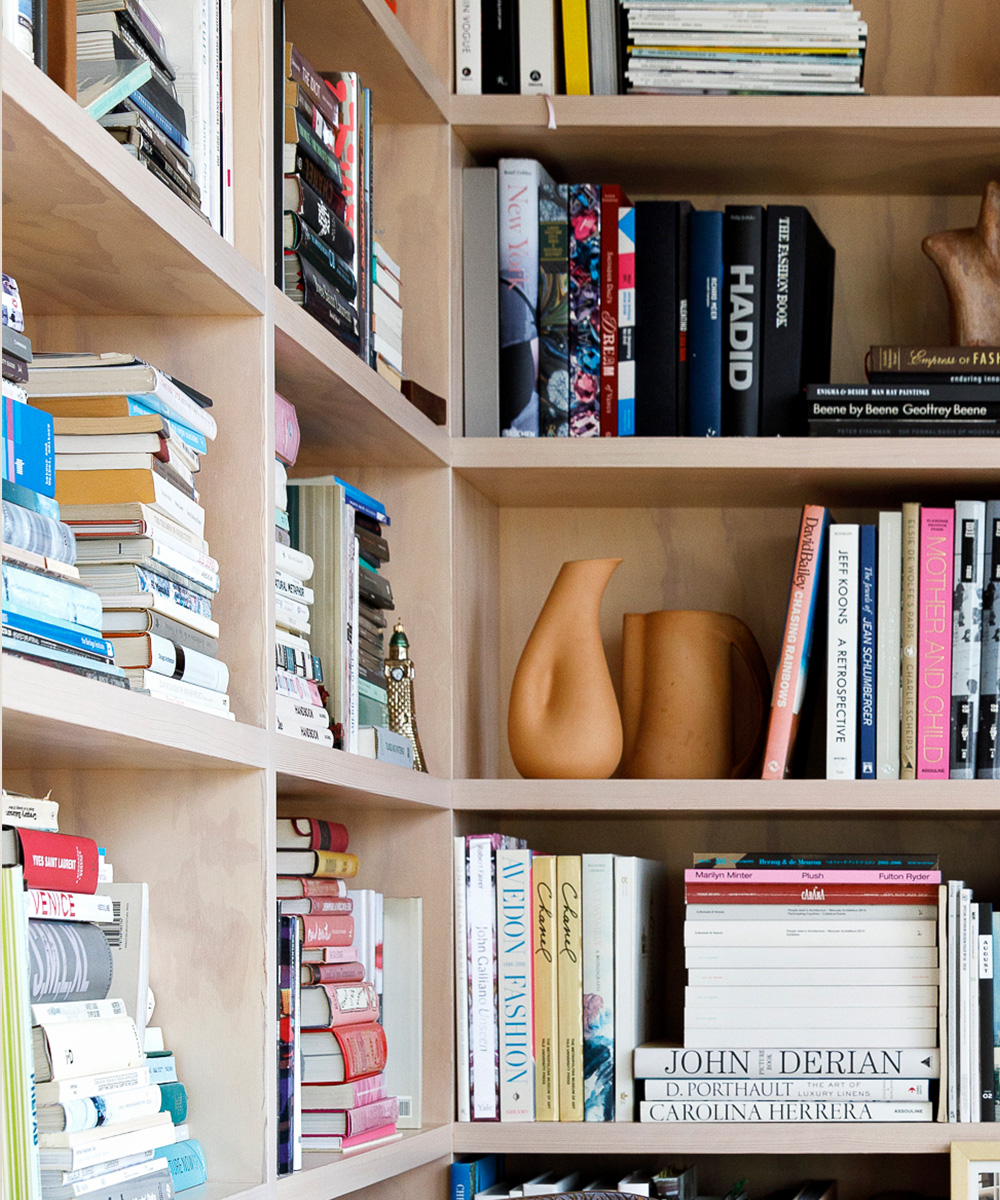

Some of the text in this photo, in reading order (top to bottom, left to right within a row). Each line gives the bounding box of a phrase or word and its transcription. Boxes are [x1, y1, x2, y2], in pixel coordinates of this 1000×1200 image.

[507, 185, 528, 290] New York
[776, 217, 790, 328] THE FASHION BOOK
[729, 265, 755, 391] HADID
[813, 403, 847, 415] Beene
[849, 403, 863, 417] by
[865, 403, 899, 415] Beene
[903, 404, 951, 418] Geoffrey
[953, 404, 987, 416] Beene
[950, 376, 982, 384] enduring
[777, 590, 804, 708] CHASING RAINBOWS
[836, 550, 849, 743] JEFF KOONS A RETROSPECTIVE
[862, 566, 874, 726] The Jewels of JEAN SCHLUMBERGER
[923, 536, 946, 763] MOTHER AND CHILD
[32, 854, 77, 870] YVES SAINT LAURENT
[695, 871, 724, 880] Marilyn
[906, 873, 930, 881] Ryder
[30, 891, 76, 917] VENICE
[535, 882, 552, 963] Chanel
[559, 882, 578, 964] Chanel
[502, 856, 527, 1084] AVEDON FASHION
[665, 1050, 903, 1074] JOHN DERIAN
[666, 1082, 794, 1096] D. PORTHAULT
[649, 1103, 760, 1120] CAROLINA
[770, 1102, 873, 1119] HERRERA
